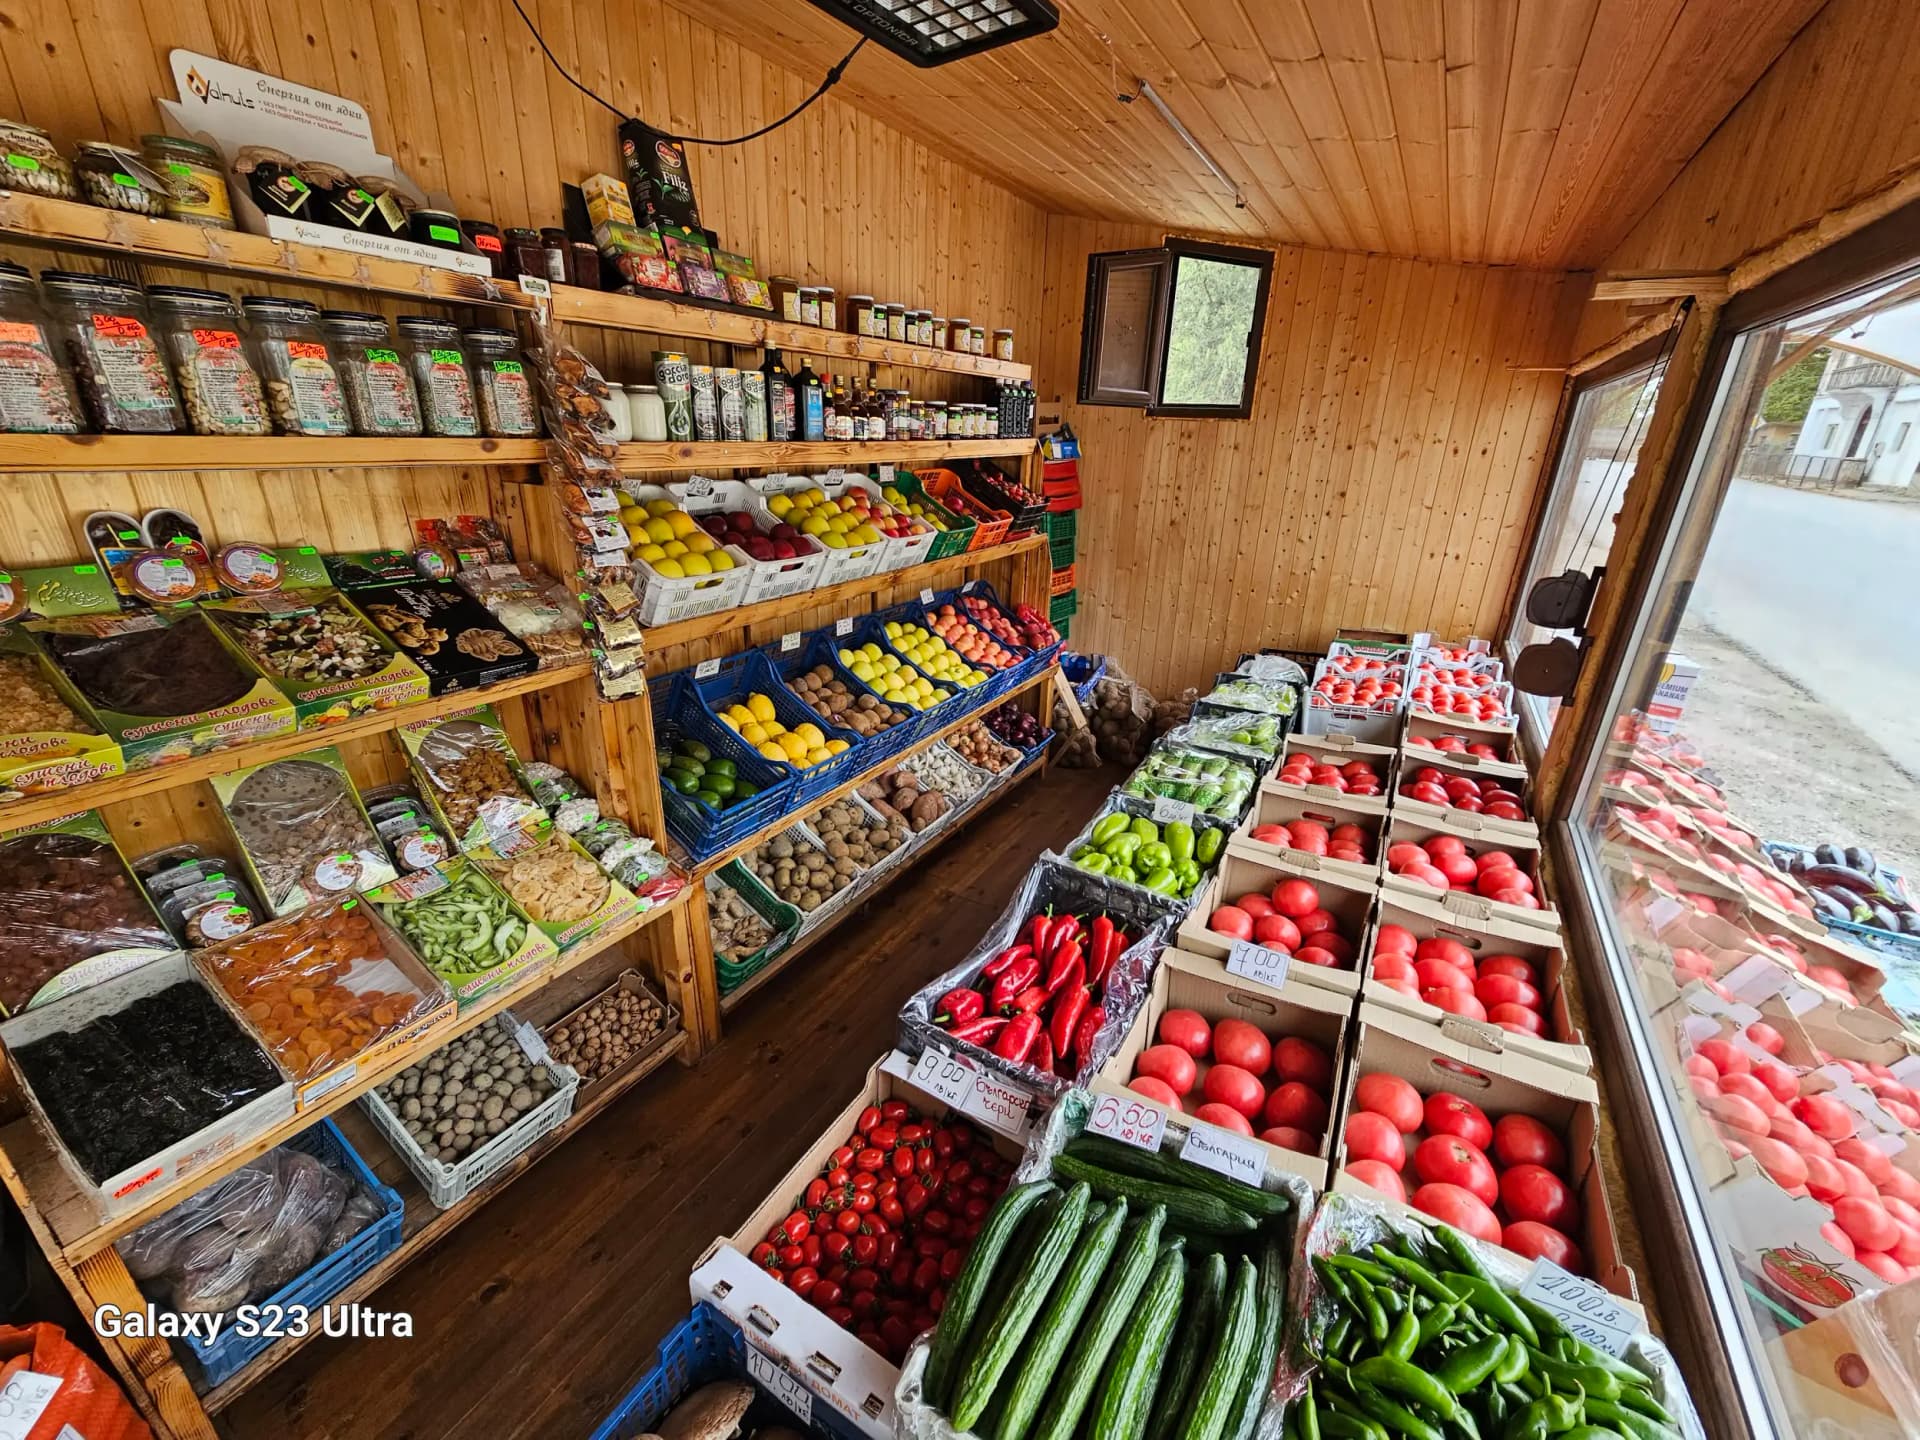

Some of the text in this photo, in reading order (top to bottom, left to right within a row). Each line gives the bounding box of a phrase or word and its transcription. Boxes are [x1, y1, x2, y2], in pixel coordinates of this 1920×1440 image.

[852, 4, 918, 46] OPTONICA
[658, 364, 688, 382] goccia
[297, 680, 359, 701] сушени
[122, 697, 279, 740] сушени плодове
[14, 759, 90, 787] сушени
